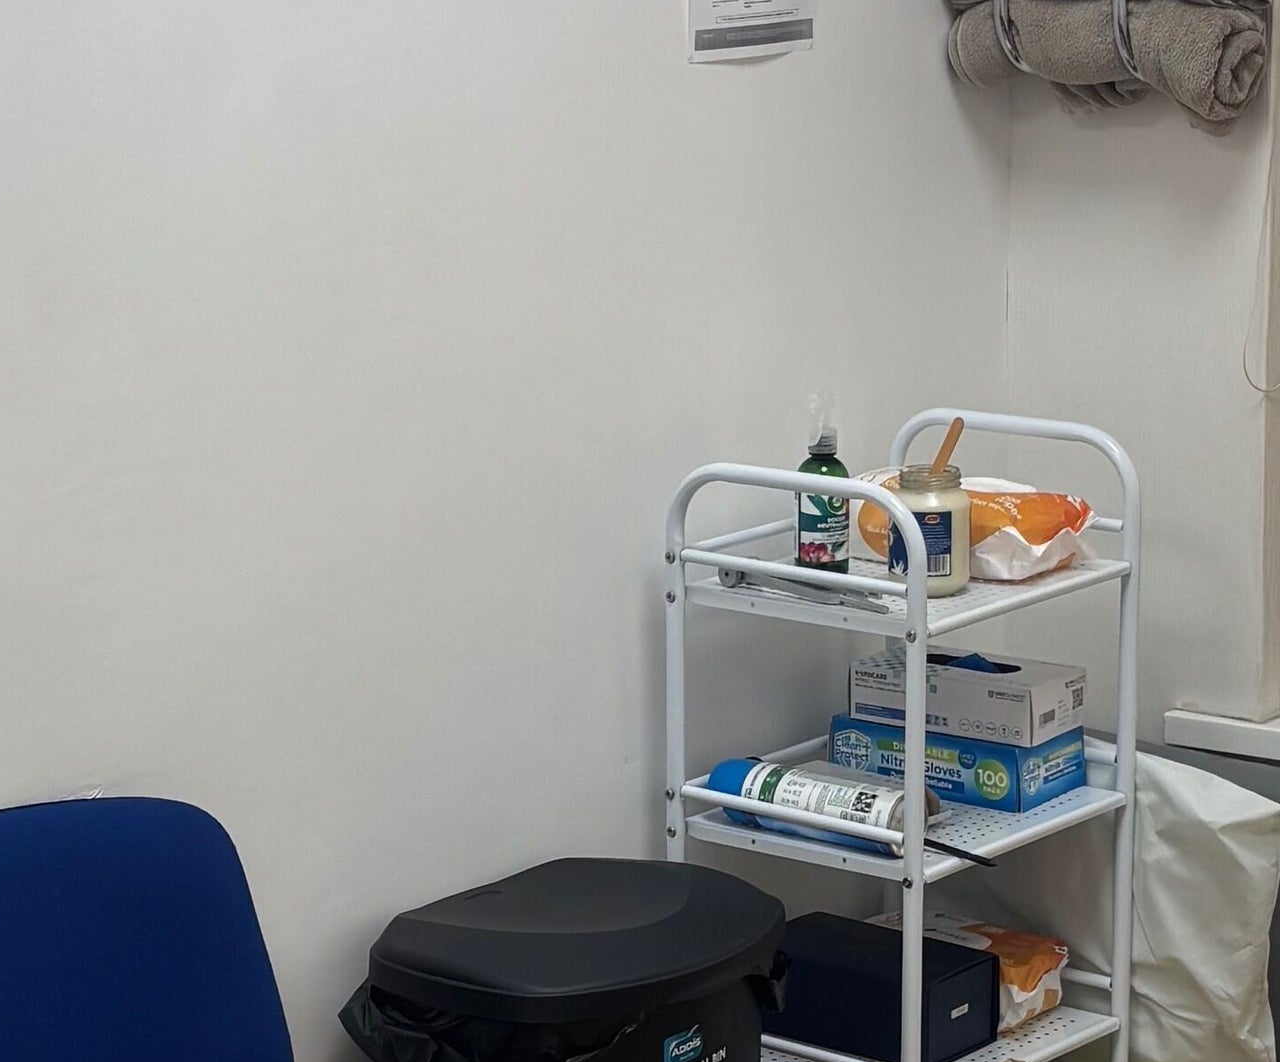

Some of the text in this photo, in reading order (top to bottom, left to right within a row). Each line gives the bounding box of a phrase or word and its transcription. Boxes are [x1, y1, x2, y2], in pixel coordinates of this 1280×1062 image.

[835, 736, 871, 752] Clean+
[835, 748, 869, 762] Protect
[976, 768, 1008, 788] 100
